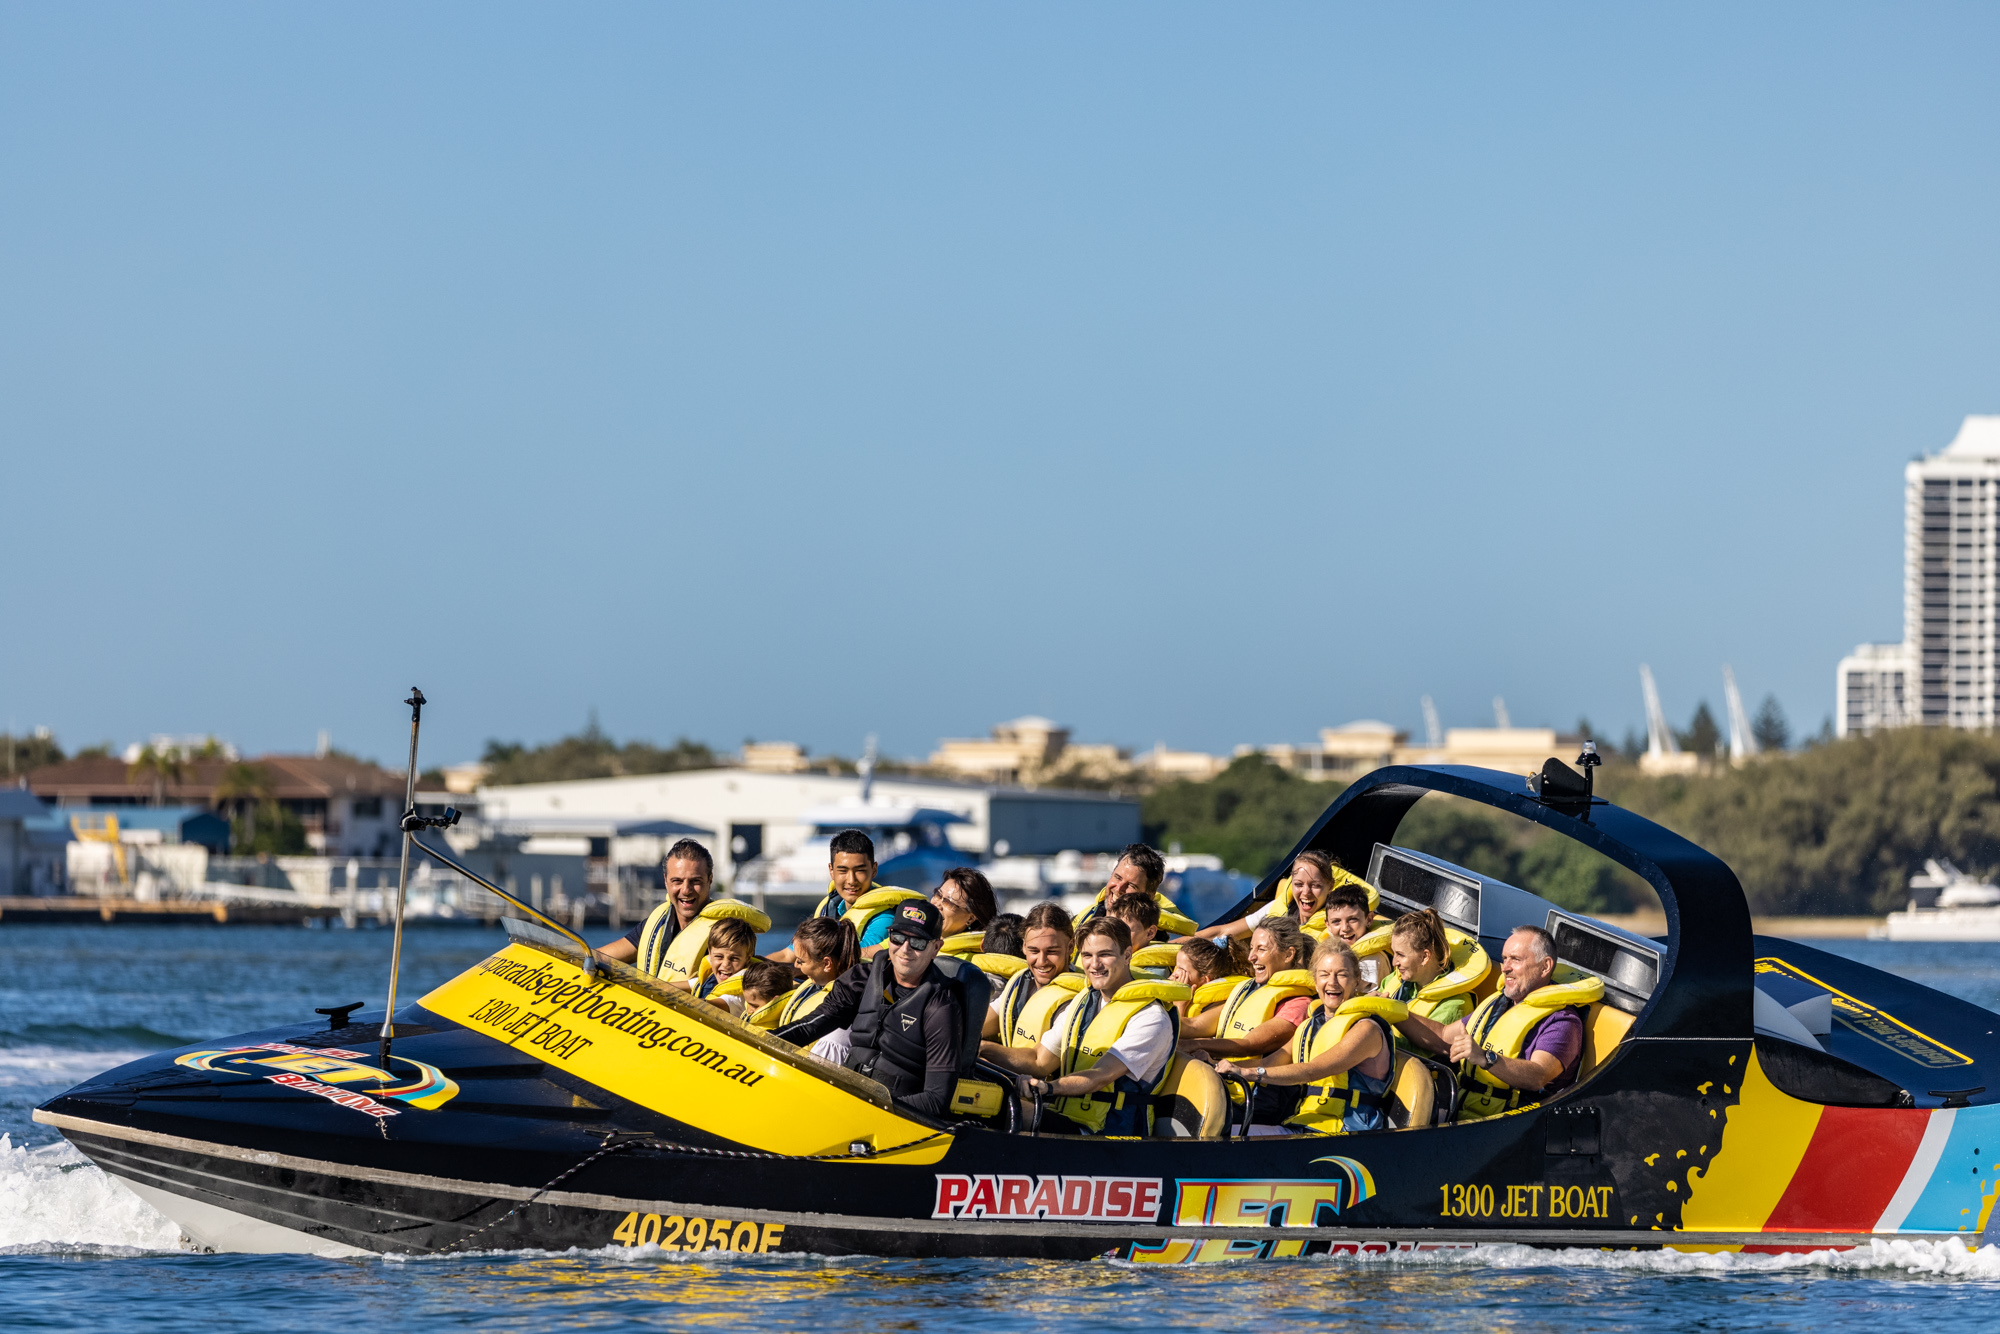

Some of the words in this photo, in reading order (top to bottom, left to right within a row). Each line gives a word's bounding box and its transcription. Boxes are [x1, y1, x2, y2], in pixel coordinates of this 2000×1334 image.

[663, 960, 687, 976] BLA
[468, 998, 520, 1026] 1300
[502, 1011, 549, 1038] JET
[529, 1023, 593, 1061] BOAT
[477, 956, 764, 1087] w.paradisejetboating.com.au
[1016, 1027, 1037, 1043] BLA
[226, 1053, 402, 1085] JET
[1082, 1046, 1104, 1058] BLA
[263, 1073, 402, 1118] BOATING
[931, 1174, 1163, 1222] PARADISE
[1129, 1178, 1343, 1262] JET
[1440, 1183, 1495, 1217] 1300
[1500, 1185, 1544, 1218] JET
[1549, 1185, 1614, 1218] BOAT
